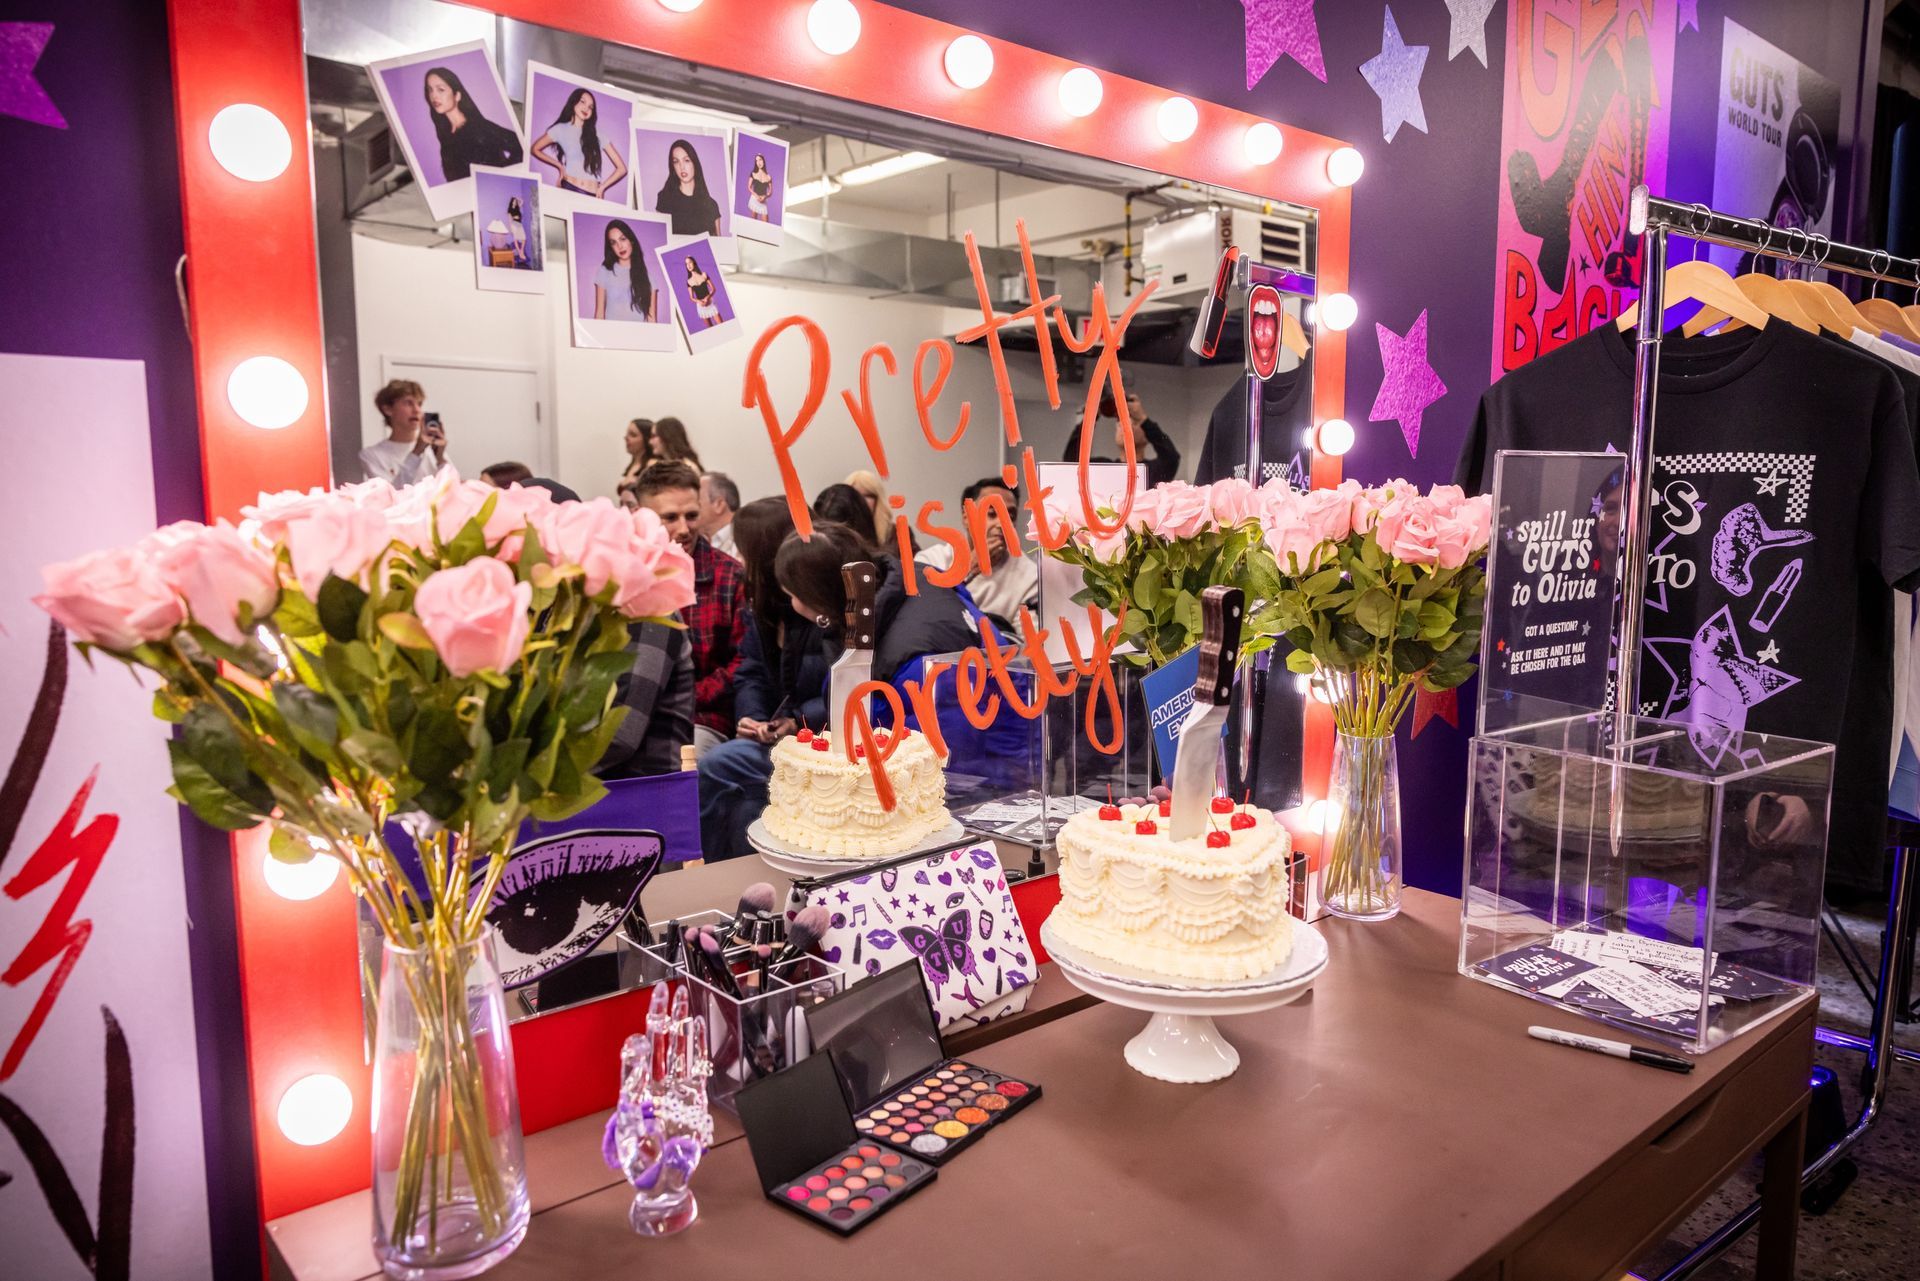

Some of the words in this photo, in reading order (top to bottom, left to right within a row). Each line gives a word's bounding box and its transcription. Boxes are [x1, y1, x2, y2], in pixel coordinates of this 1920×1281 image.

[1729, 47, 1785, 122] GUTS
[1728, 104, 1759, 137] WORLD
[1761, 122, 1782, 148] TOUR
[1517, 510, 1567, 543] spill
[1571, 518, 1596, 540] ur
[1522, 538, 1593, 574] GUTS
[1511, 581, 1531, 607] to
[1537, 572, 1597, 604] Olivia
[1525, 625, 1538, 638] GOT
[1538, 624, 1545, 636] A
[1545, 620, 1579, 636] QUESTION?
[1510, 650, 1525, 664] ASK
[1525, 649, 1533, 661] IT
[1533, 647, 1549, 660] HERE
[1550, 644, 1564, 658] AND
[1564, 643, 1572, 655] IT
[1572, 641, 1587, 654] MAY
[1510, 663, 1520, 676] BE
[1520, 659, 1546, 674] CHOSEN
[1546, 657, 1559, 669] FOR
[1560, 655, 1572, 667] THE
[1572, 653, 1586, 666] Q&A
[844, 597, 1128, 812] pretty
[1151, 683, 1197, 729] AMERI
[1524, 974, 1539, 983] to
[1536, 960, 1575, 977] Olivia
